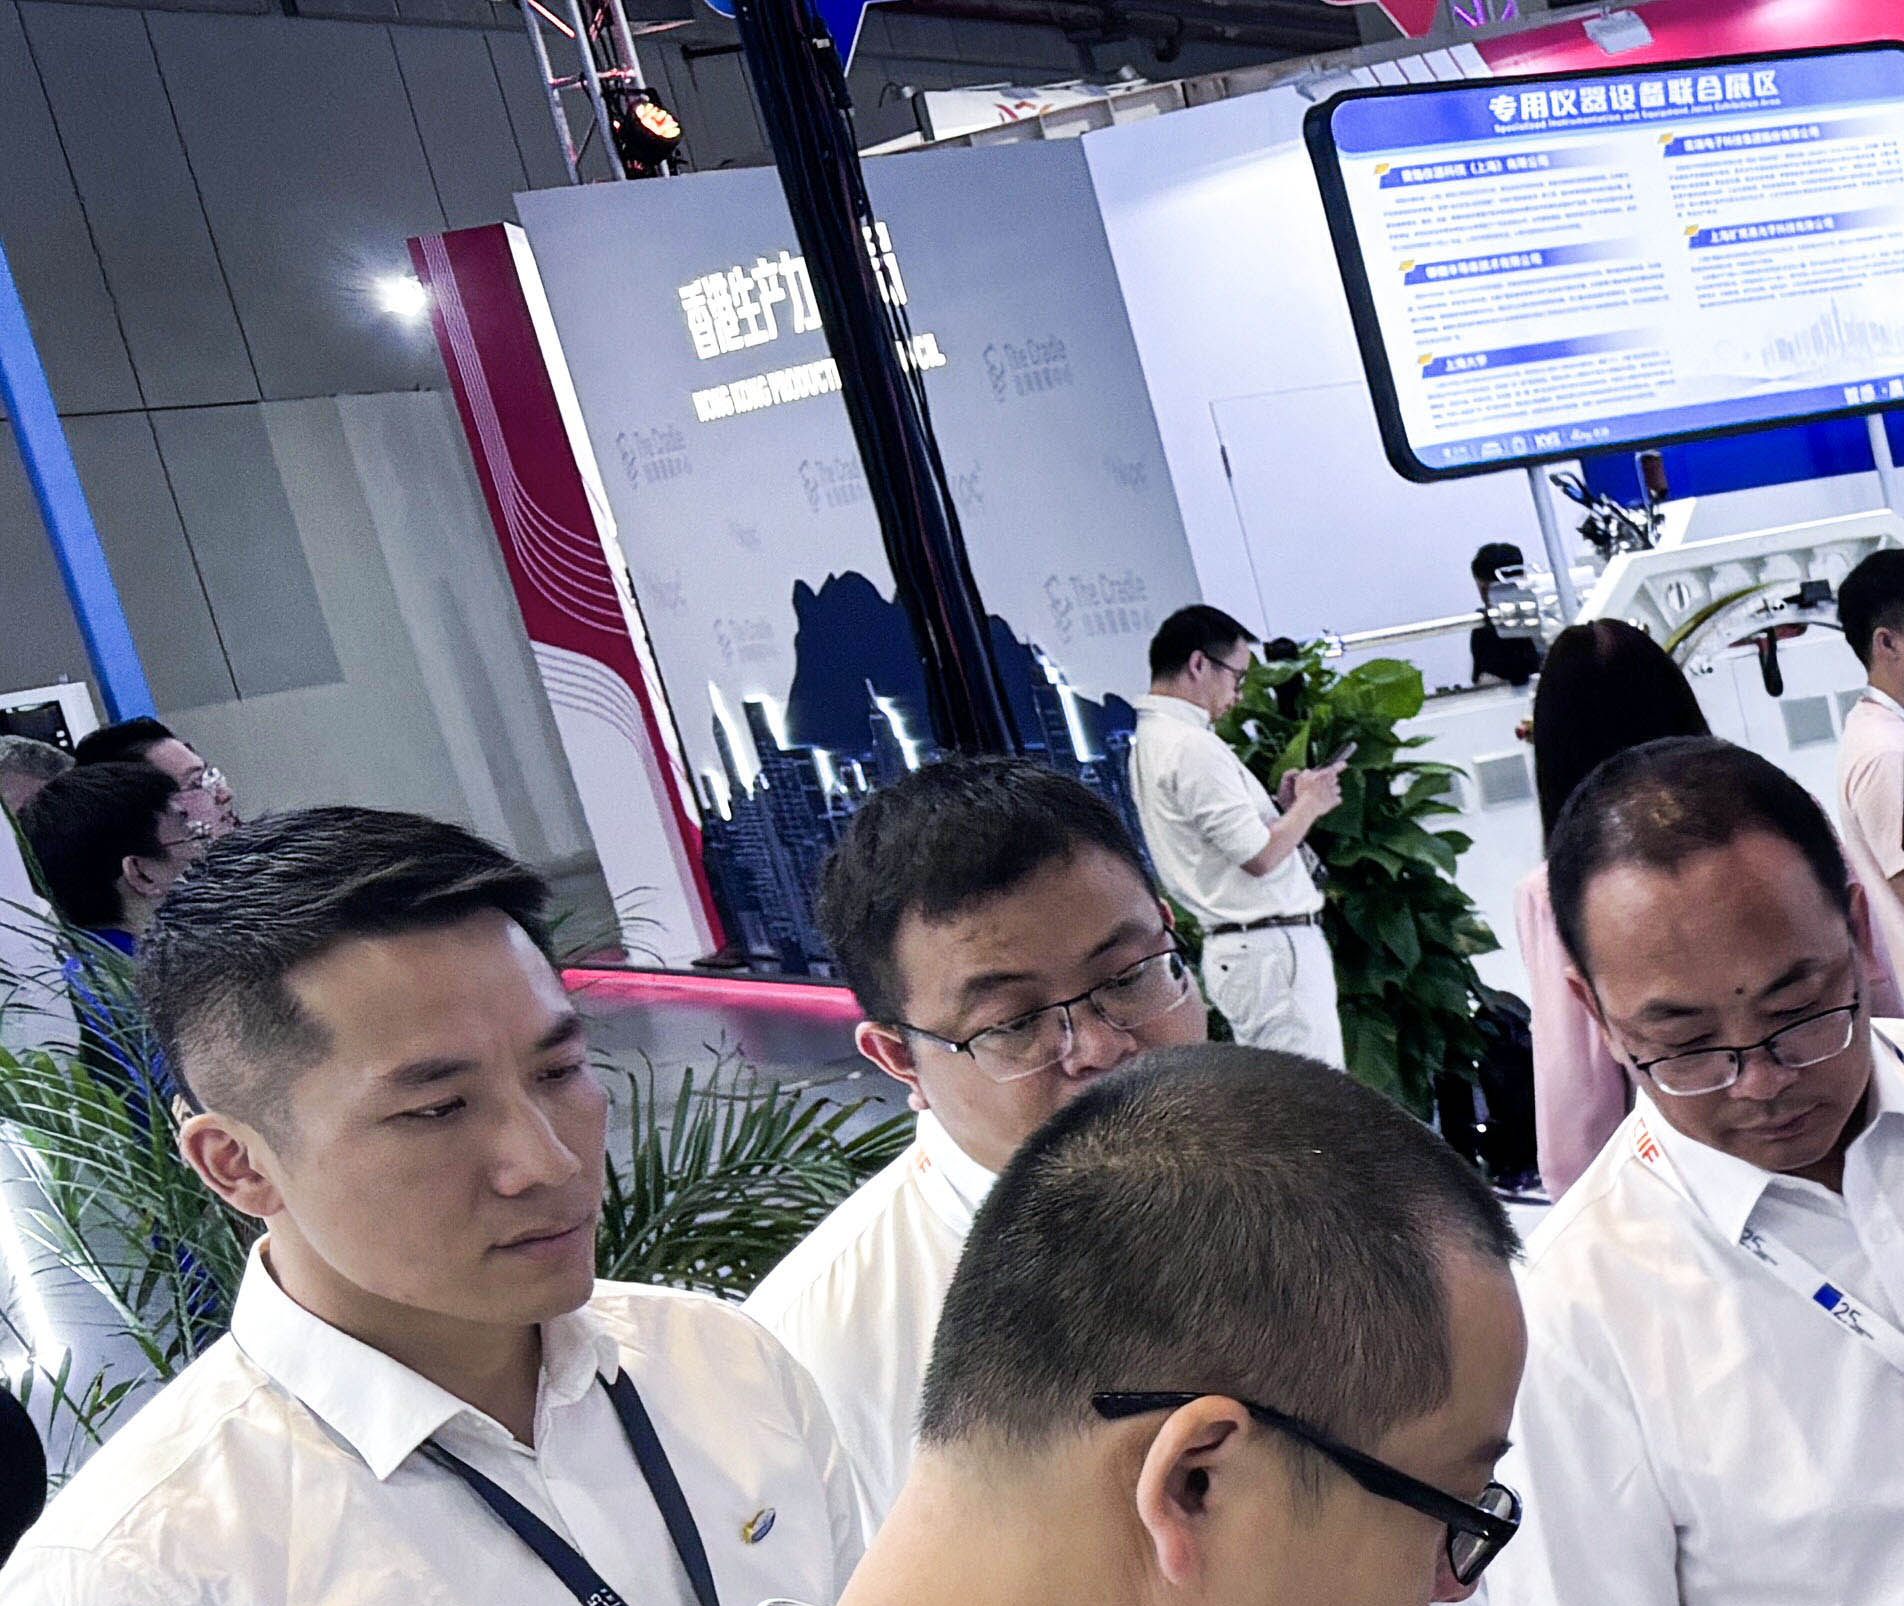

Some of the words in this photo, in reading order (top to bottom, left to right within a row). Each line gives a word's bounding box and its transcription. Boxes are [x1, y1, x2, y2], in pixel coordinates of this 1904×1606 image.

[1488, 70, 1780, 123] 专用仪器设备联合展区
[728, 374, 773, 414] KONG
[767, 357, 843, 405] PRODUCTI
[1833, 1301, 1862, 1325] 25
